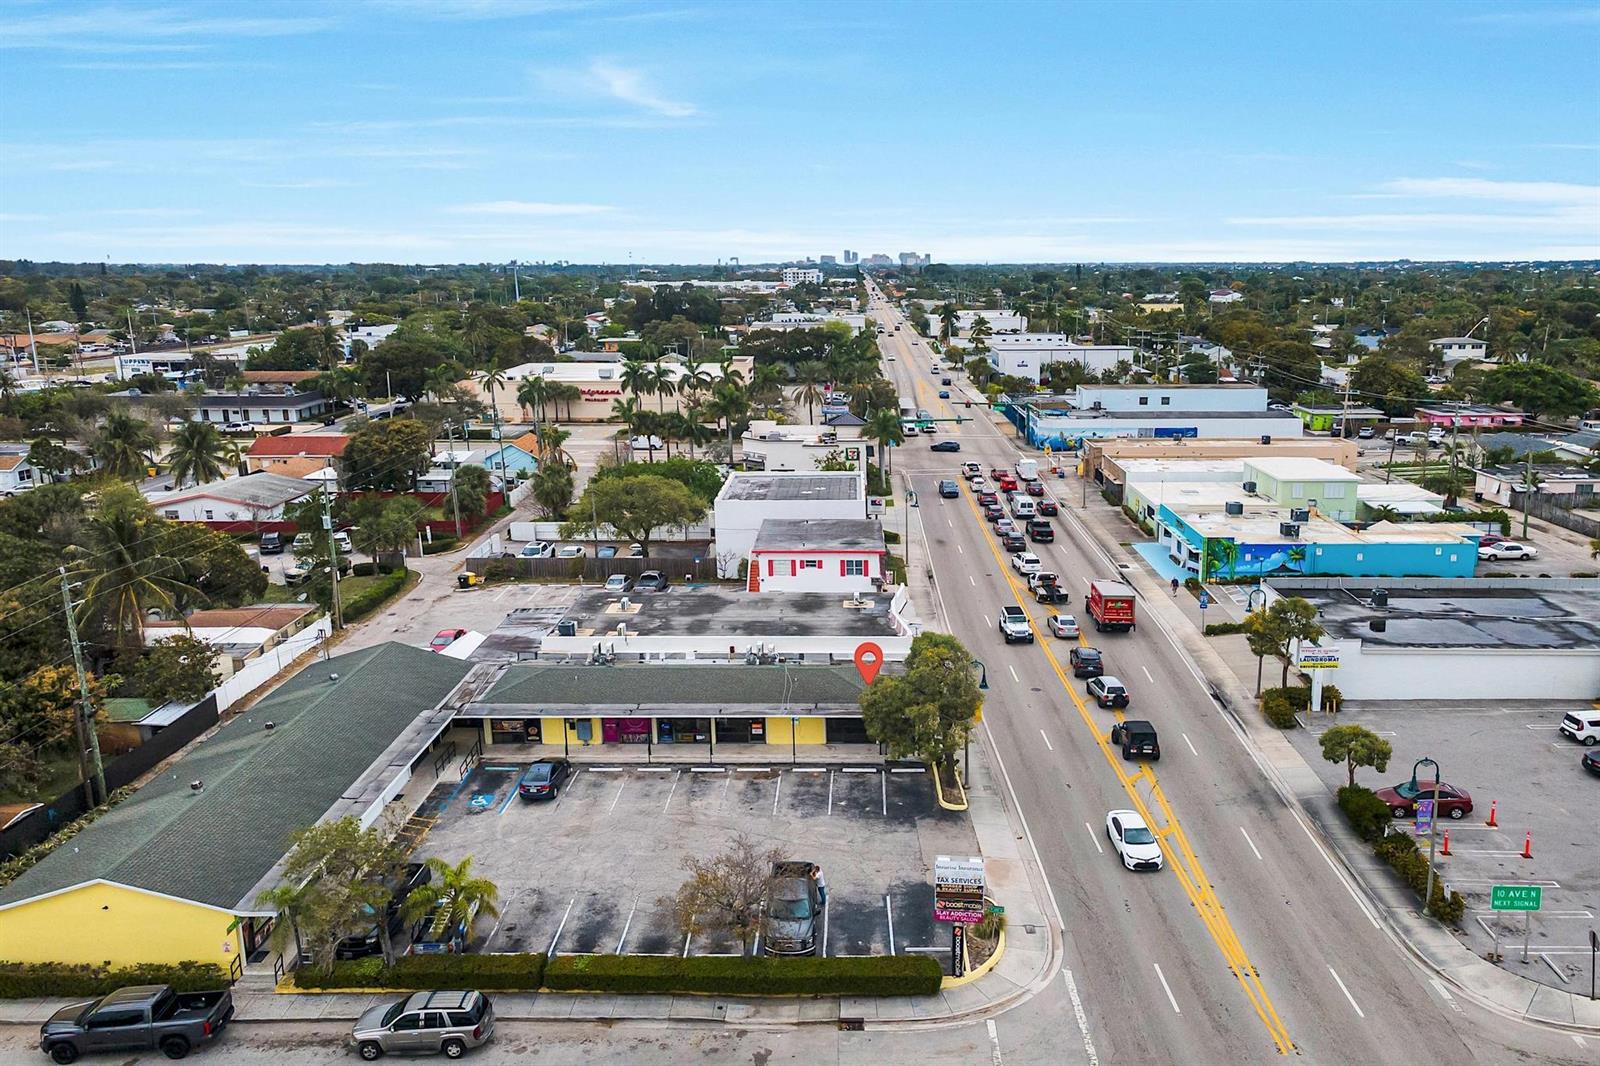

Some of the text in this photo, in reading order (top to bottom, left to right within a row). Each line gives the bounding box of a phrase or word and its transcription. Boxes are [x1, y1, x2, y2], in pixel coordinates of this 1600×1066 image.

[950, 877, 982, 885] SERVICES
[1497, 889, 1537, 898] 10 AVE N
